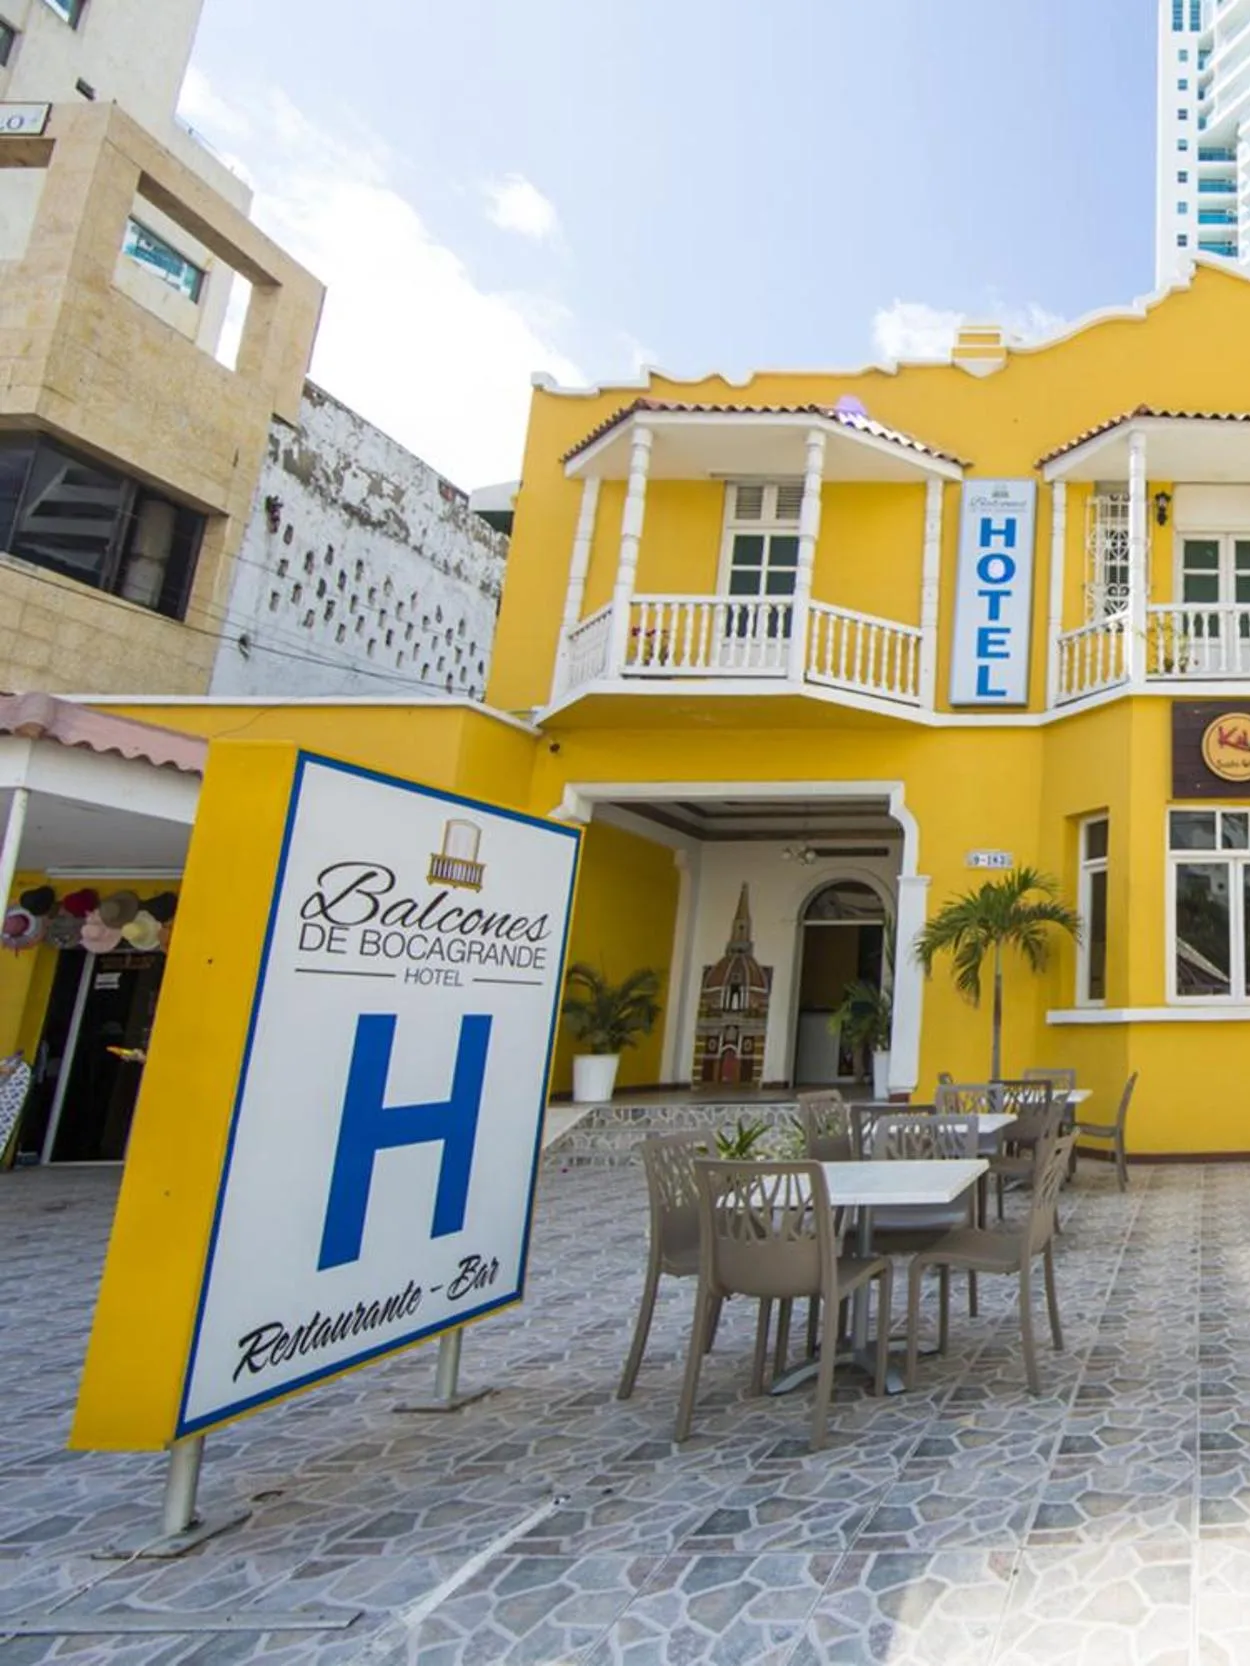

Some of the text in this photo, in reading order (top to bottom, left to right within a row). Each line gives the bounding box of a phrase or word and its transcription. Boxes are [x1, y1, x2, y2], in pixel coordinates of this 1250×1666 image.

[976, 517, 1017, 697] HOTEL
[298, 923, 548, 971] DE BOCAGRANDE
[299, 861, 551, 943] Balcones
[403, 966, 465, 988] HOTEL
[316, 1013, 494, 1273] H
[232, 1278, 423, 1383] Restaurante
[446, 1254, 501, 1303] Bar
